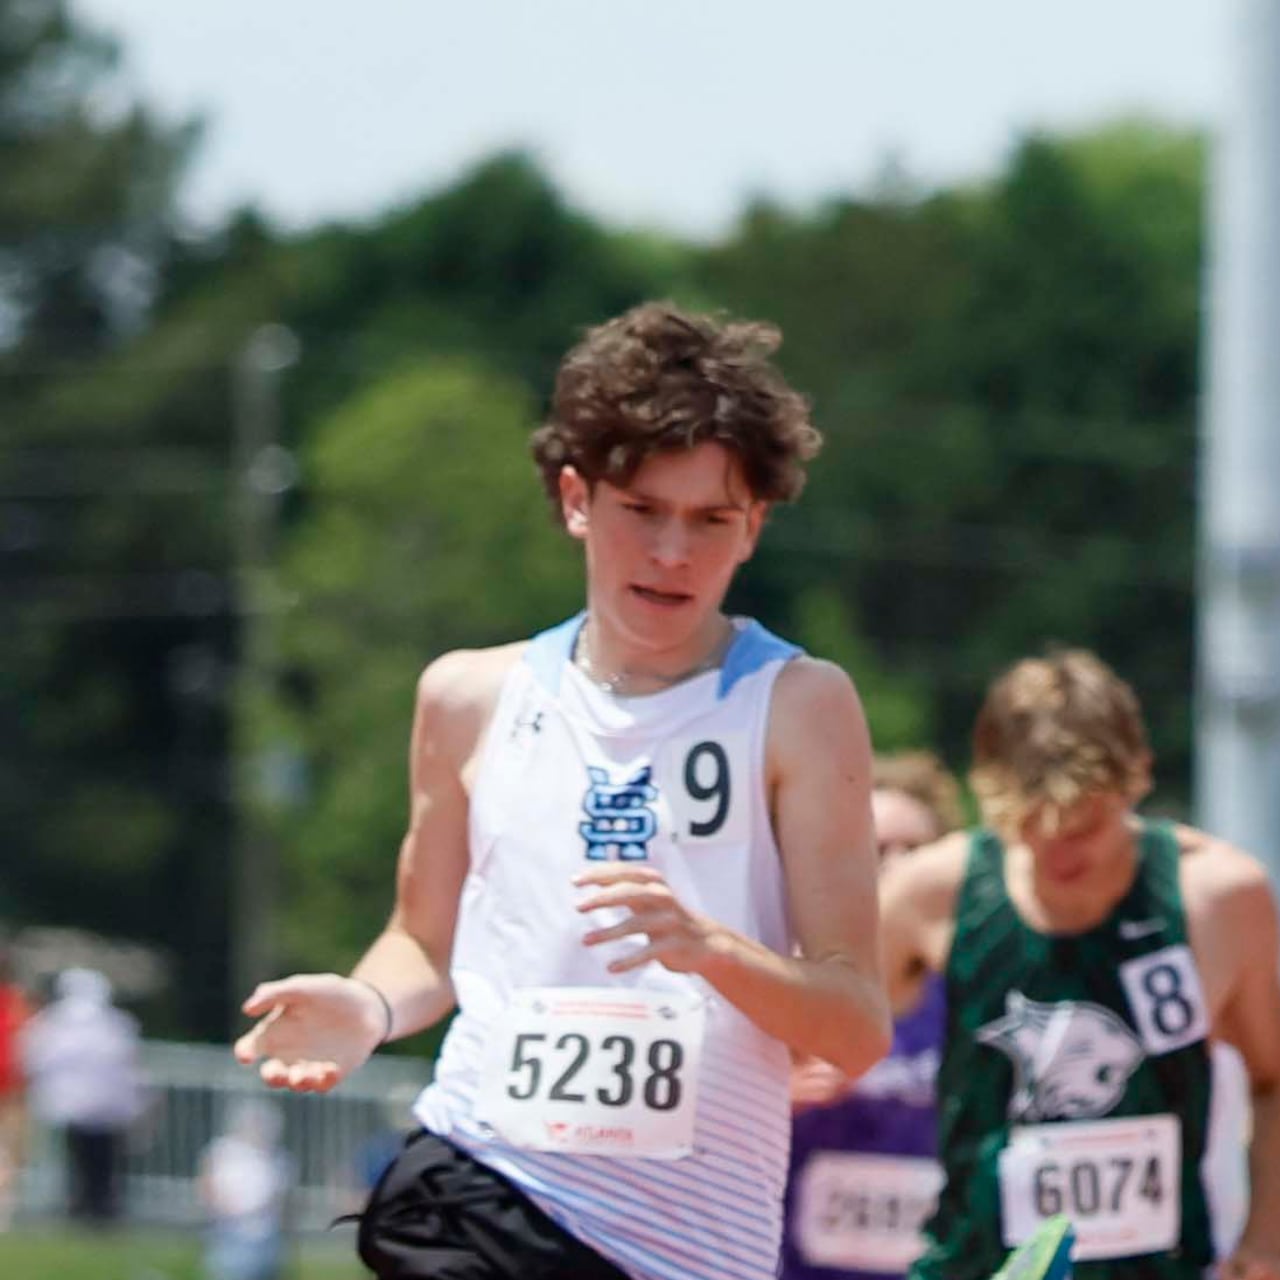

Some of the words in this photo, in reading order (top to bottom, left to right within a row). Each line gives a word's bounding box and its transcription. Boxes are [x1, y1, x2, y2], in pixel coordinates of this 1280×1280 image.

[684, 740, 731, 838] 9
[1144, 964, 1194, 1036] 8
[506, 1033, 684, 1111] 5238
[1034, 1156, 1163, 1218] 6074
